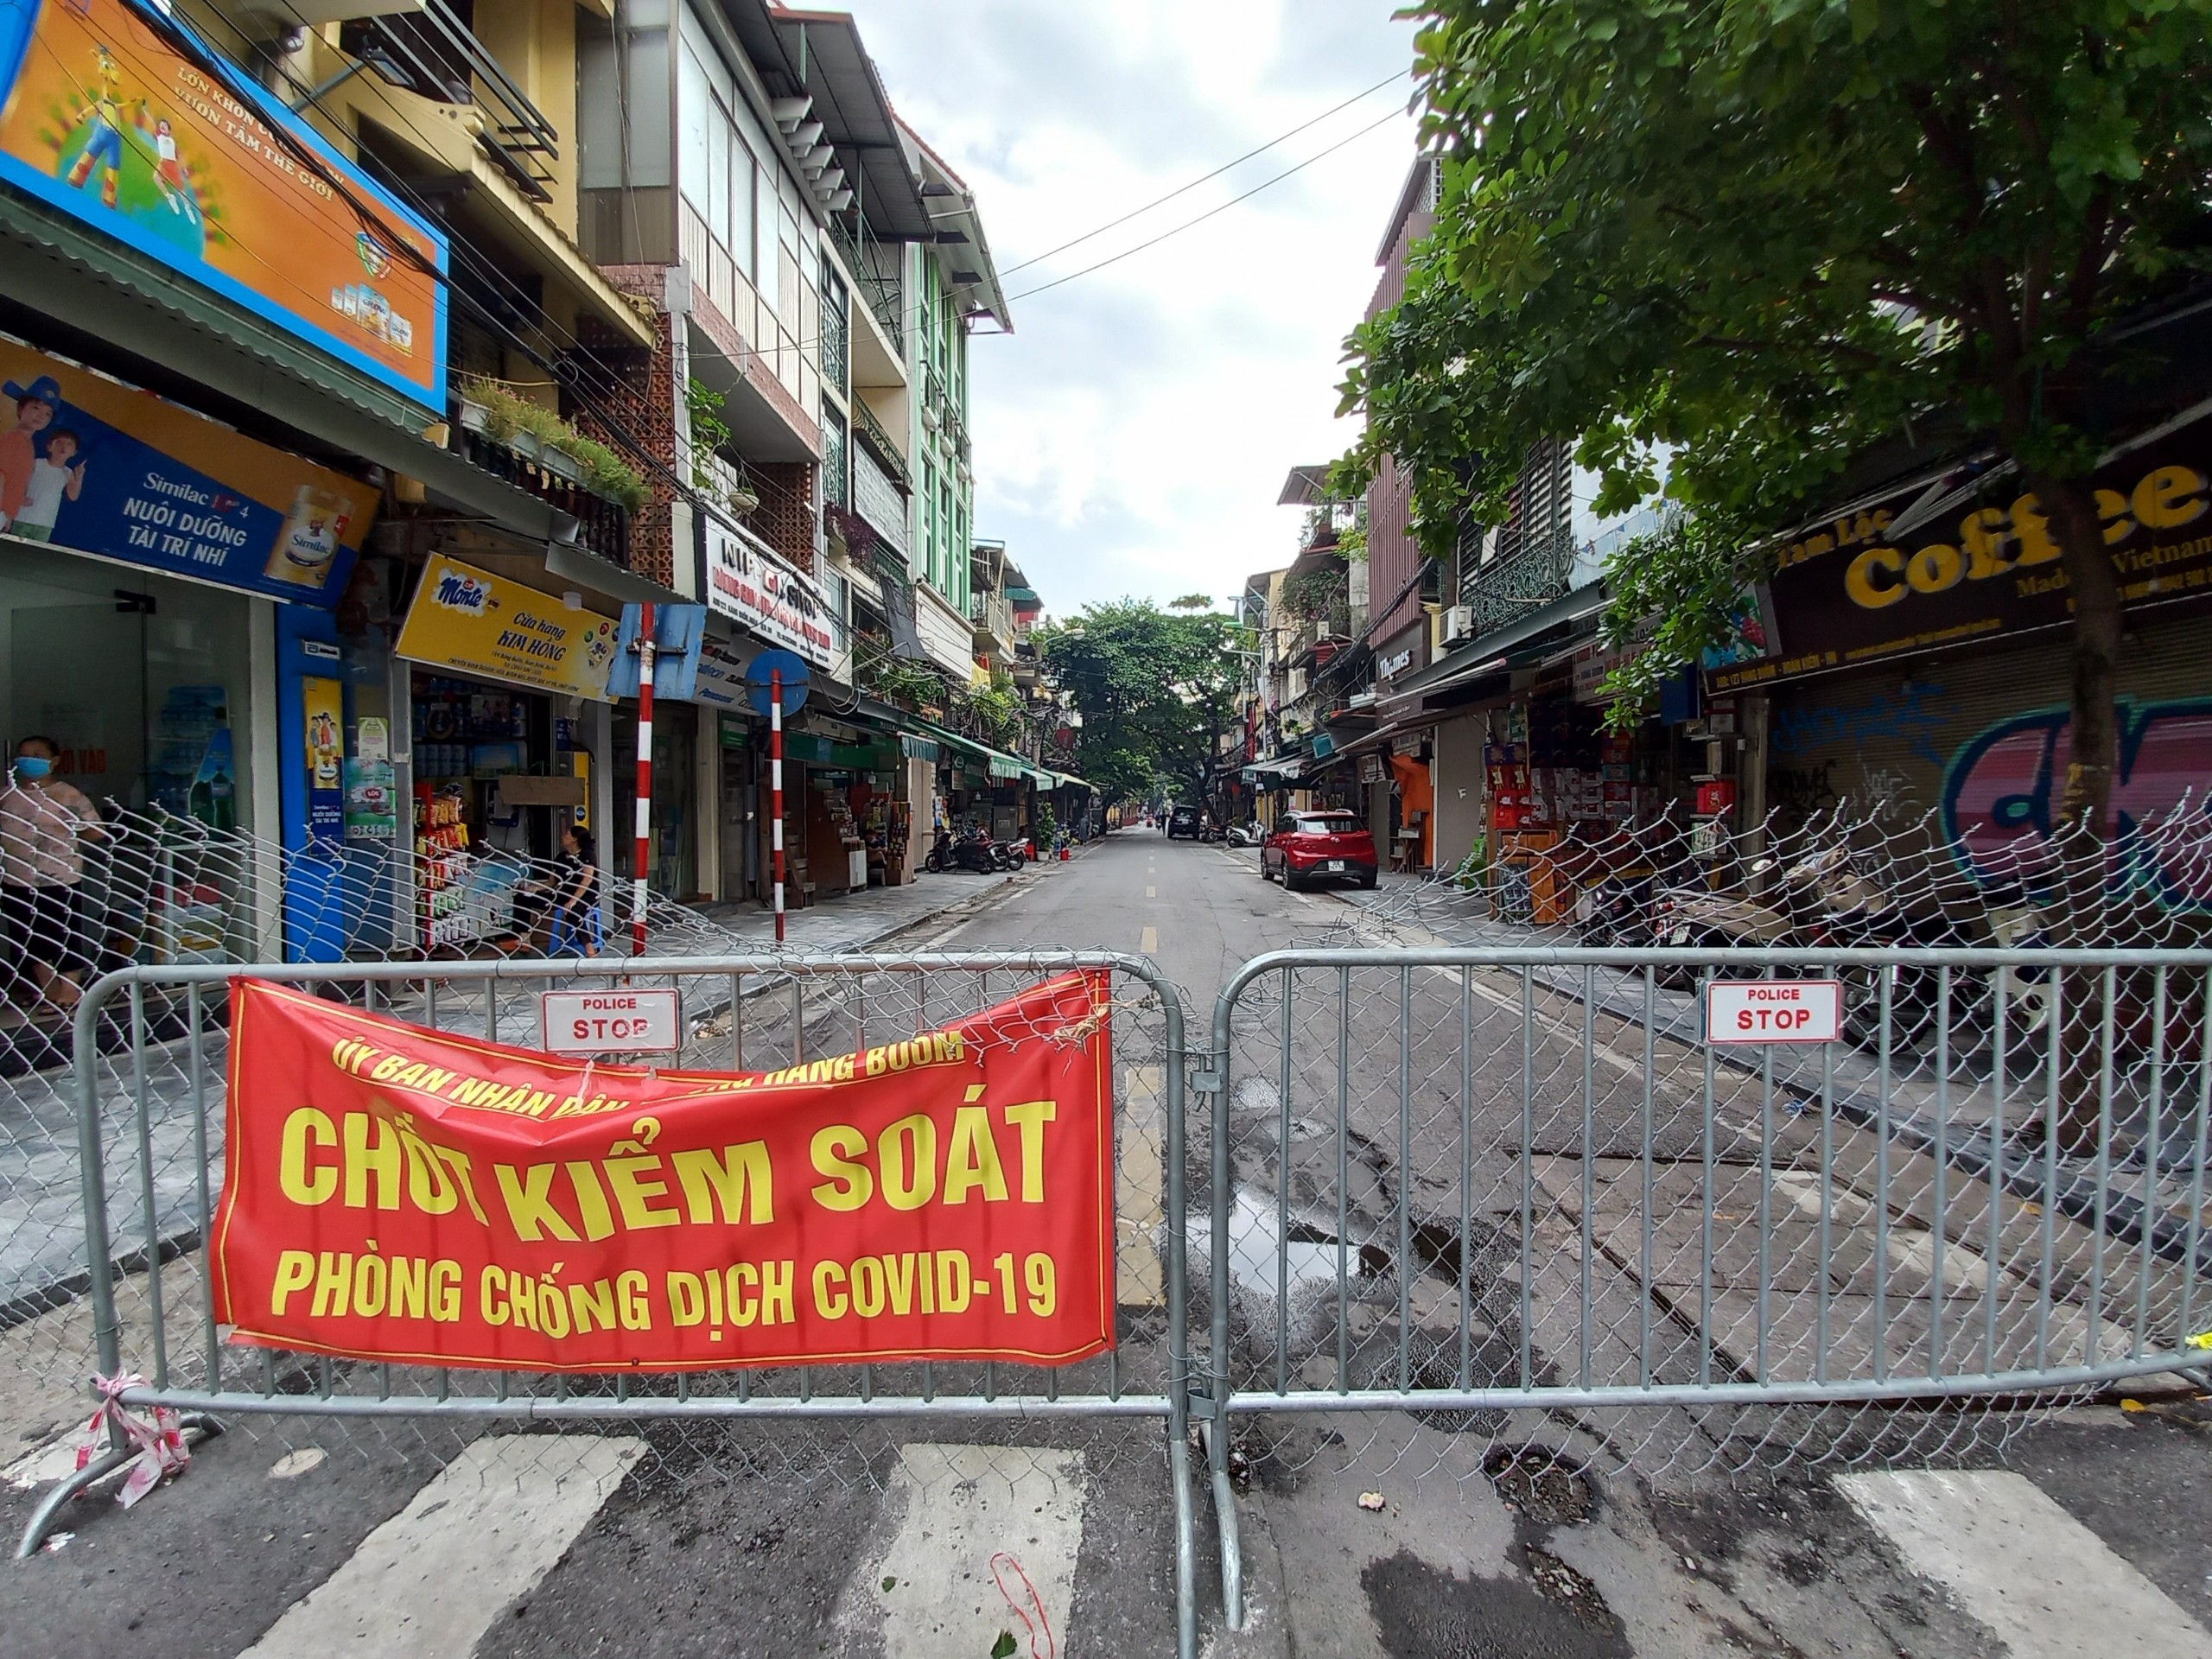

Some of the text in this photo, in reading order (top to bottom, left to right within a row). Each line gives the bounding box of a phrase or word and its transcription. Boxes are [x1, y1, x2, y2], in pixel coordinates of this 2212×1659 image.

[143, 472, 210, 505] Similac
[239, 505, 250, 518] 4
[123, 497, 248, 547] NUÔI DƯỠNG
[128, 524, 232, 567] TÀI TRÍ NHÍ
[291, 535, 330, 554] Similac
[438, 577, 483, 607] Monte
[497, 630, 528, 652] KIM
[537, 620, 566, 641] hàng
[582, 998, 637, 1010] POLICE
[1747, 989, 1801, 1001] POLICE
[573, 1019, 649, 1039] STOP
[1737, 1009, 1811, 1030] STOP
[371, 1054, 458, 1094] BAN
[448, 1082, 556, 1118] NHÂN
[493, 1116, 774, 1243] KIỂM
[809, 1084, 1058, 1211] SOÁT
[270, 1238, 1058, 1343] PHÒNG CHỐNG DỊCH COVID-19
